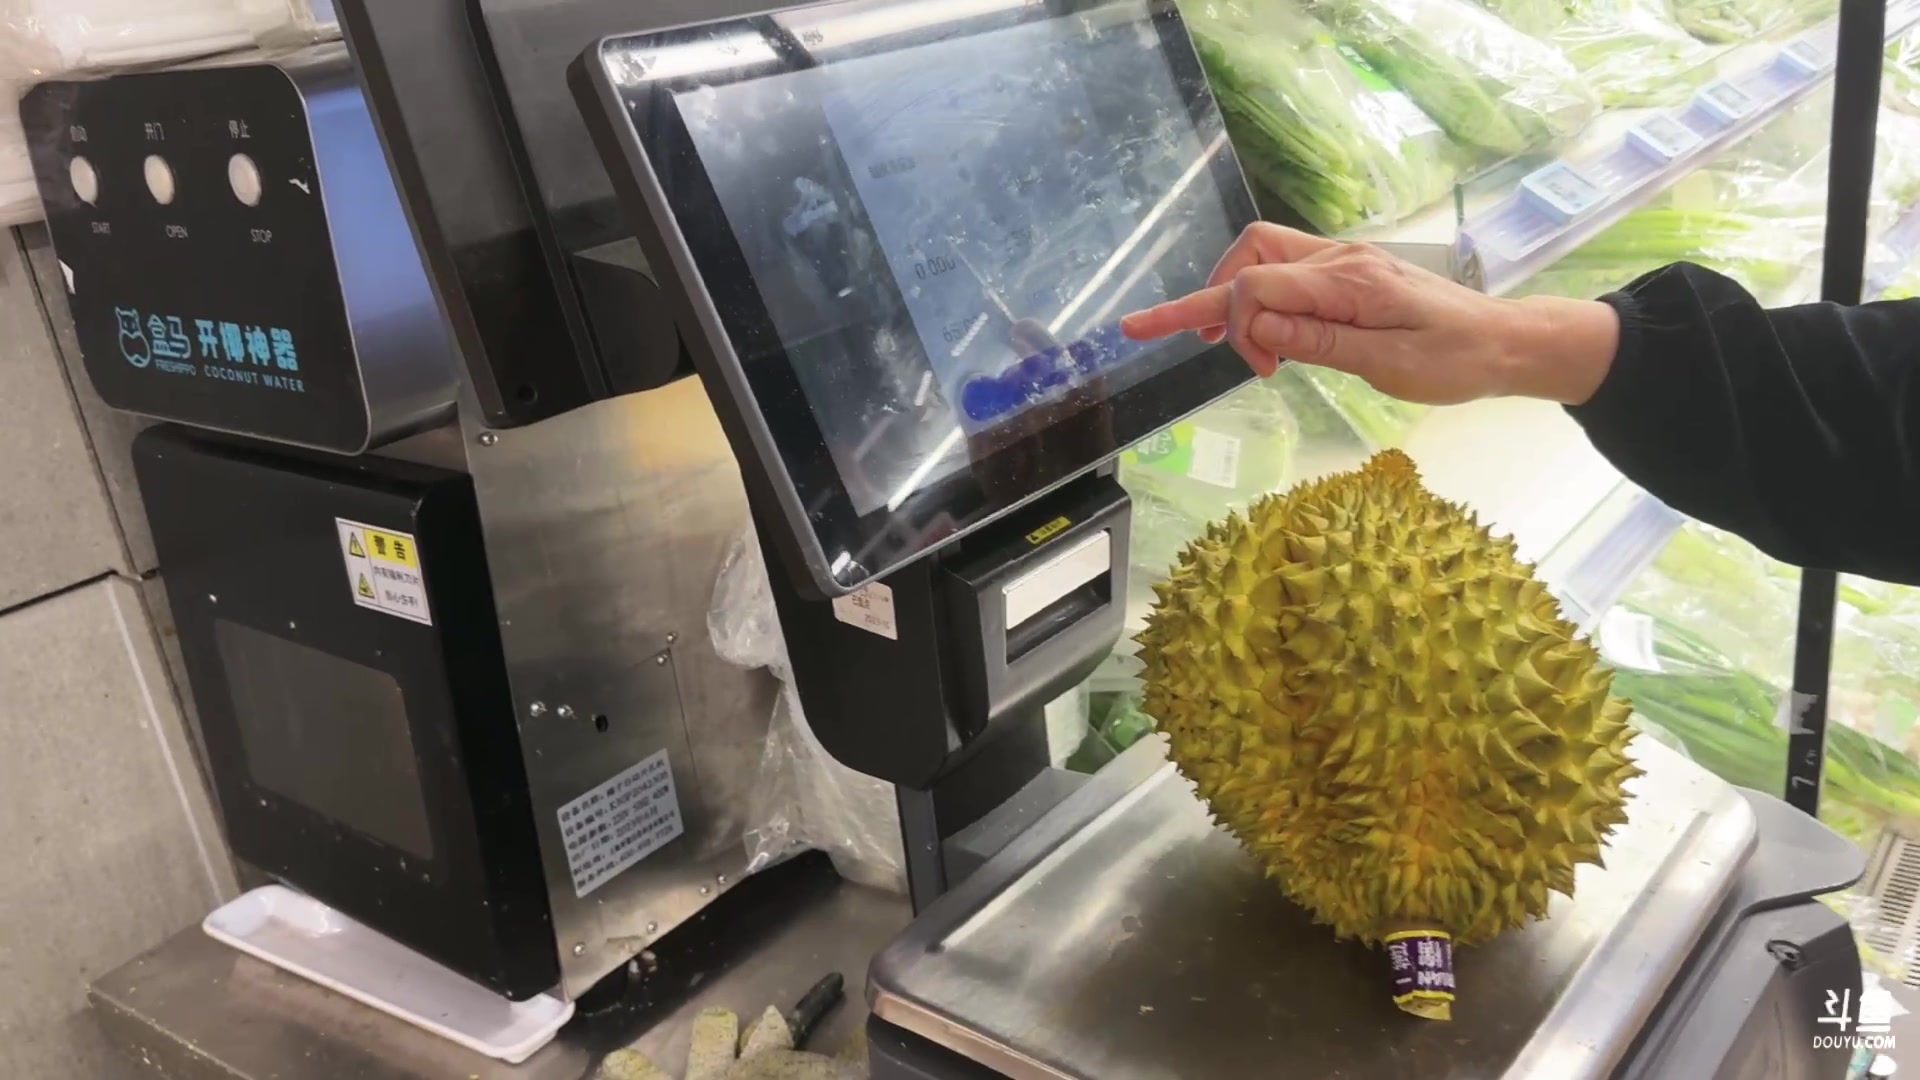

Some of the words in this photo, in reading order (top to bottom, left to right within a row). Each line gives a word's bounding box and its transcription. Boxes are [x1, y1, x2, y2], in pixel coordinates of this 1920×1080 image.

[144, 122, 165, 141] 开门
[228, 119, 250, 139] 停止
[165, 224, 189, 239] OPEN
[250, 228, 273, 243] STOP
[147, 313, 191, 359] 盒马
[203, 364, 259, 385] COCONUT
[261, 373, 305, 393] WATER
[373, 535, 406, 560] 警告
